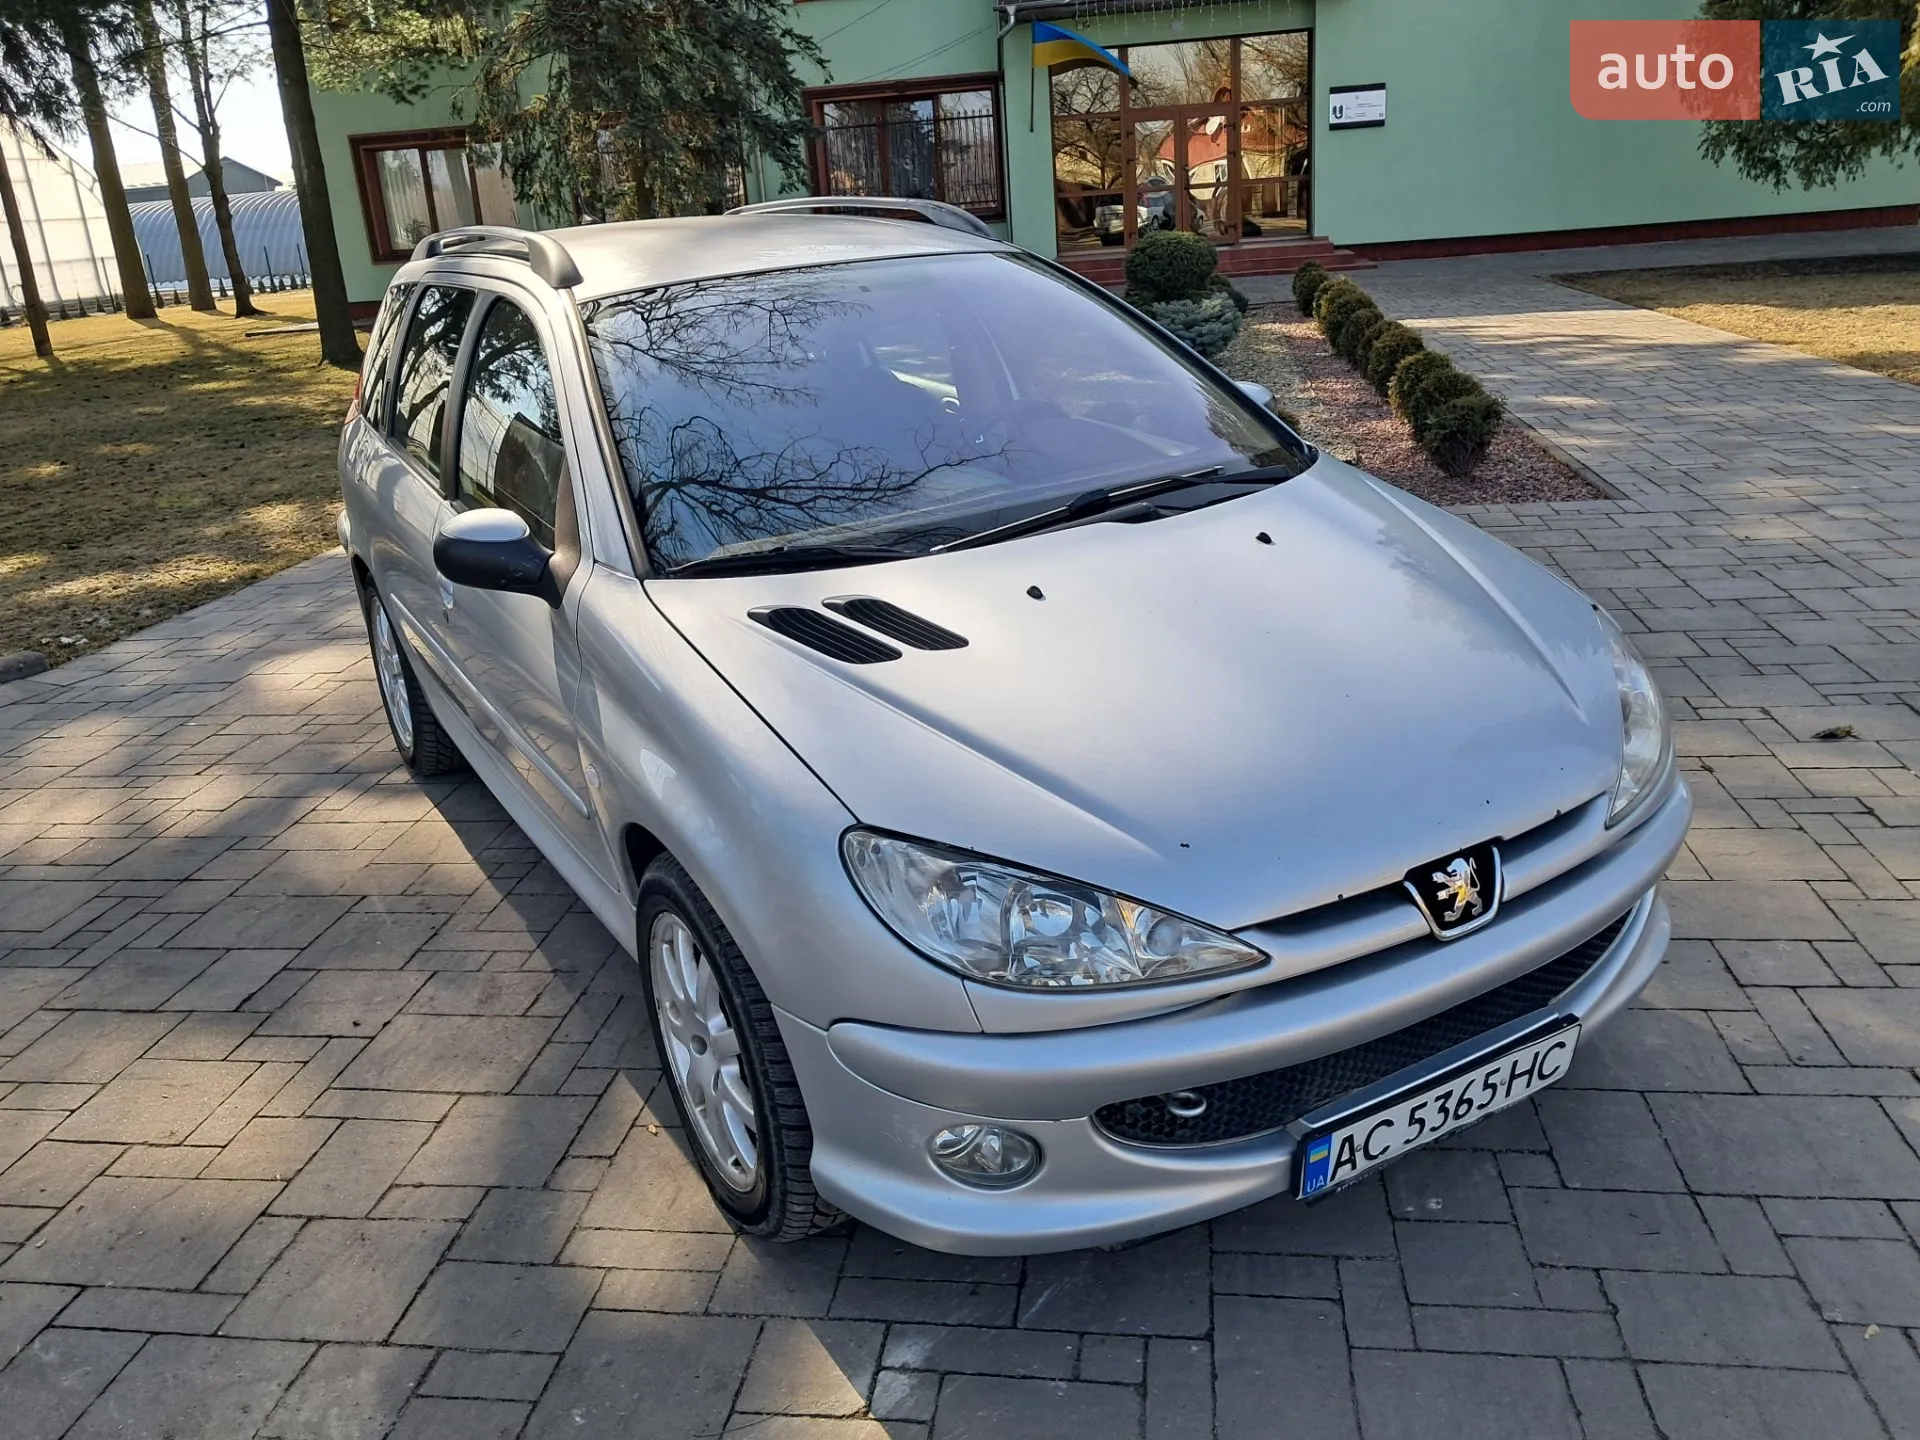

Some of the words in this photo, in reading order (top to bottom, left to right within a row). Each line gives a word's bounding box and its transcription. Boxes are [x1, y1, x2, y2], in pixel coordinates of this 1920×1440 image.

[1329, 1118, 1395, 1182] AC
[1403, 1067, 1501, 1145] 5365
[1504, 1041, 1566, 1098] HC
[1306, 1175, 1326, 1193] UA
